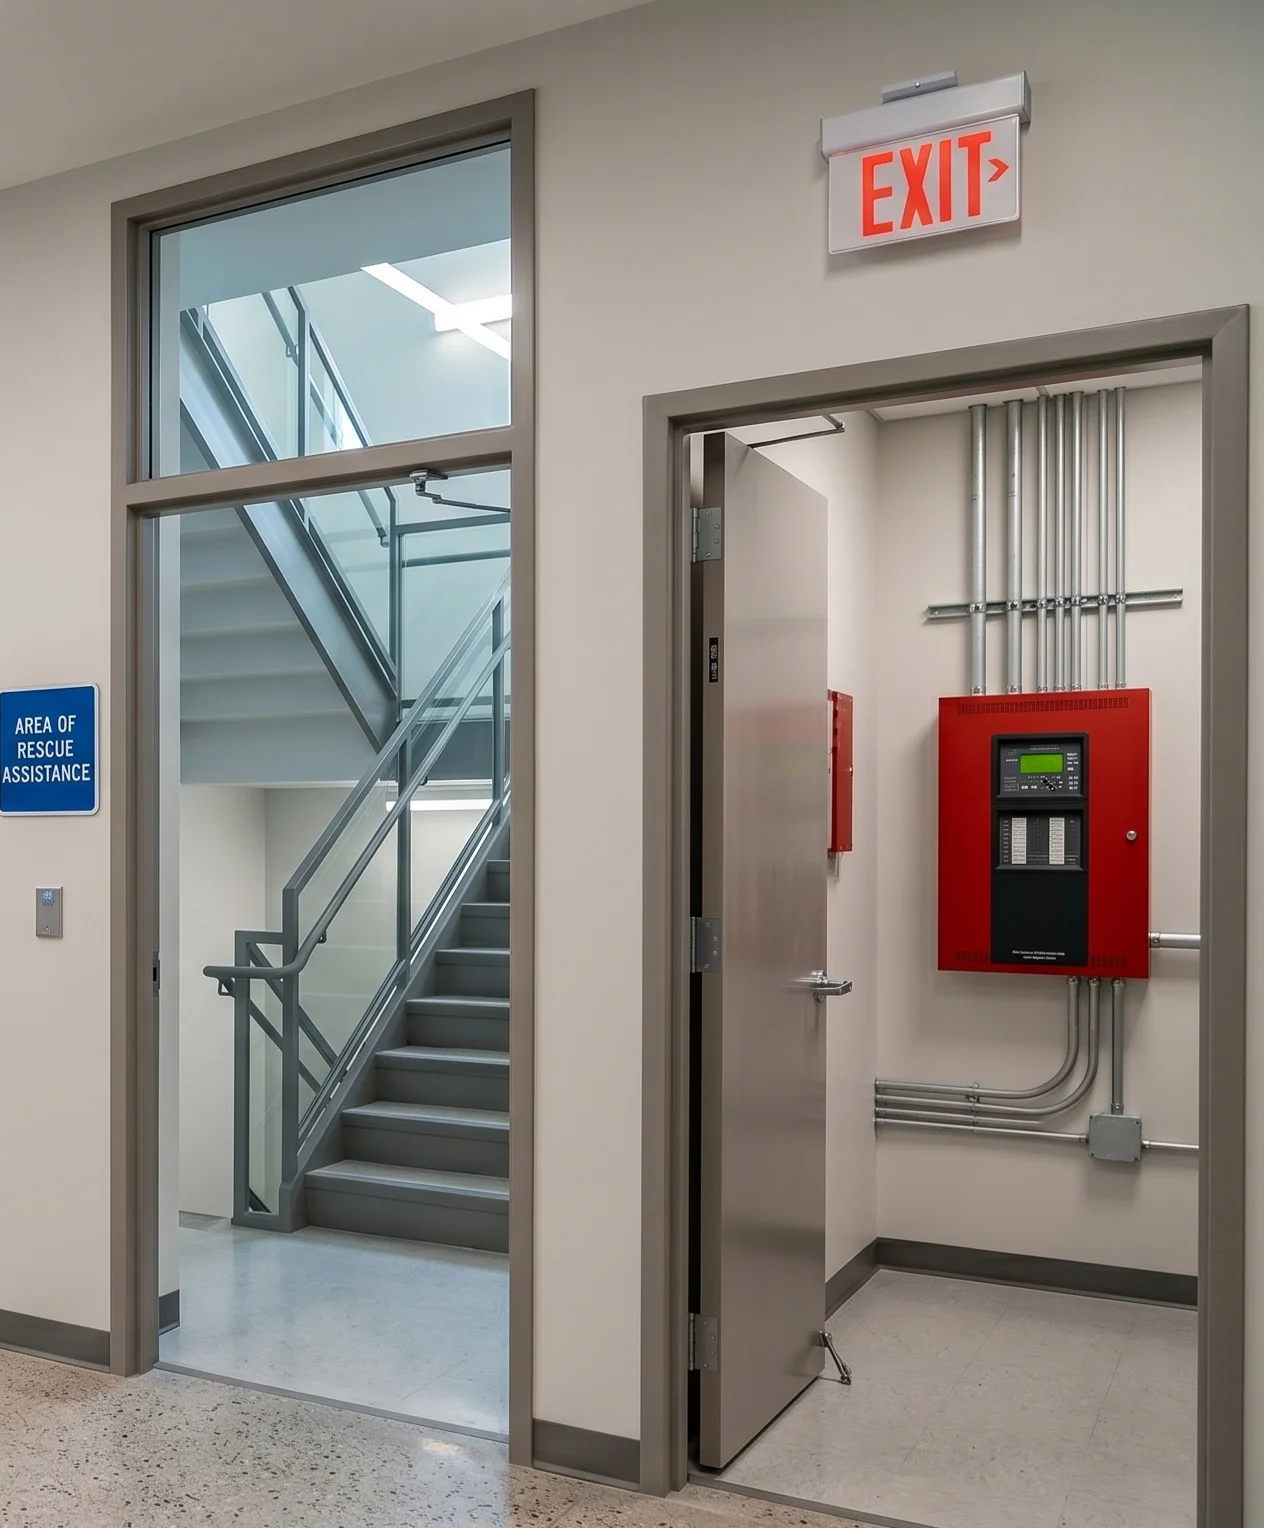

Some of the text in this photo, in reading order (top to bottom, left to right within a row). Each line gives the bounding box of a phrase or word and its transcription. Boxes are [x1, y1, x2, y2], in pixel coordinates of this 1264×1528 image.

[861, 130, 992, 237] EXIT
[15, 714, 77, 735] AREA OF
[17, 739, 74, 759] RESCUE
[2, 763, 91, 784] ASSISTANCE
